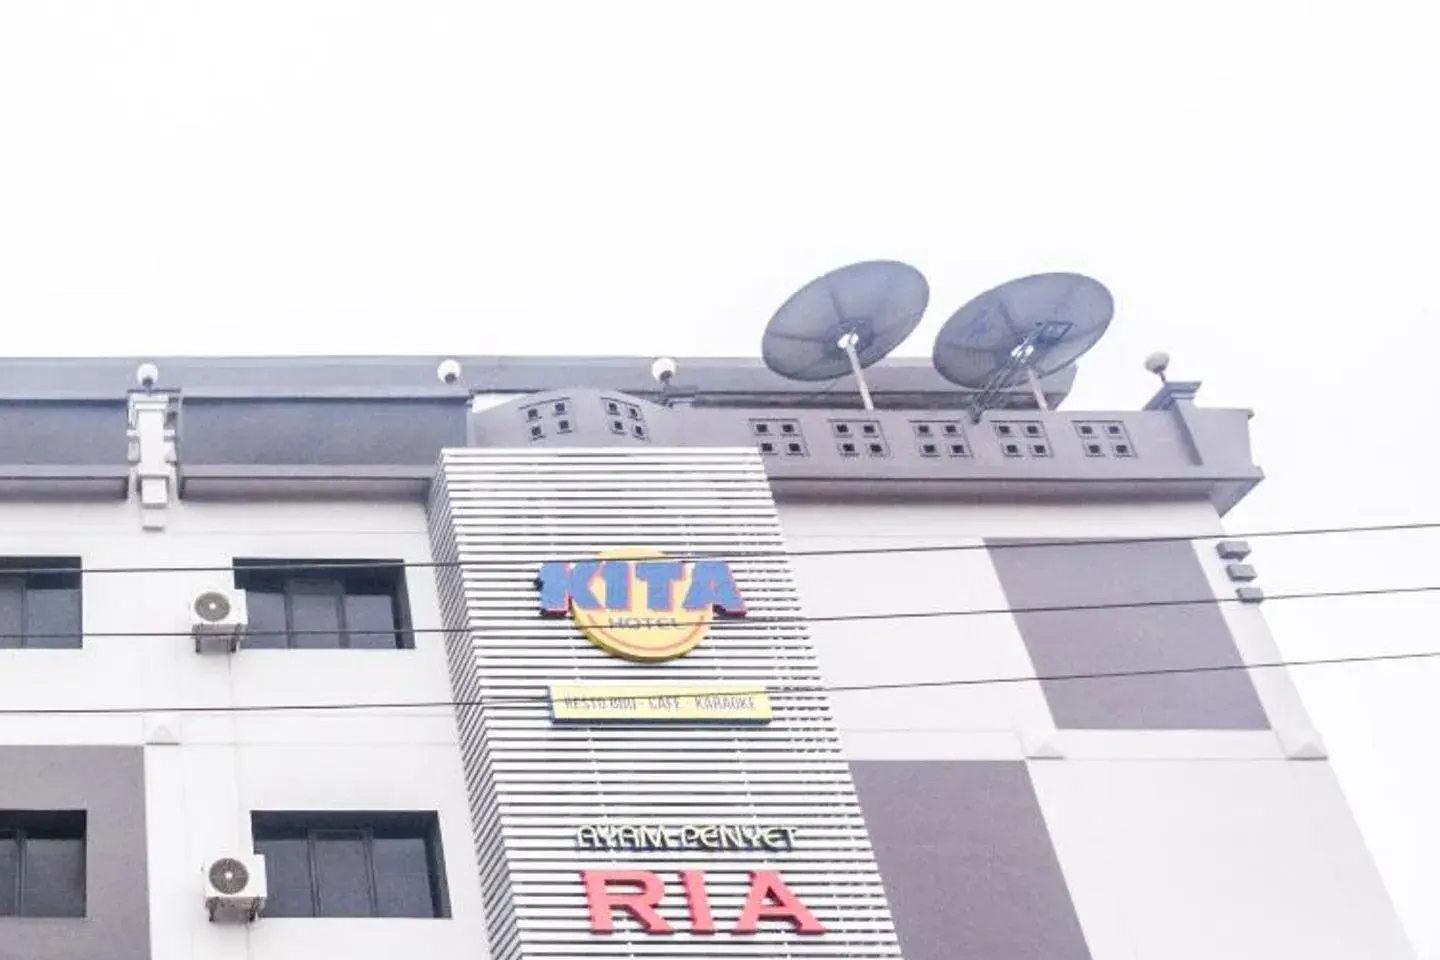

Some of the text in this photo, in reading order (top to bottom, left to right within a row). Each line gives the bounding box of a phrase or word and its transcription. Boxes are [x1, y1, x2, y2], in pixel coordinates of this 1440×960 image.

[537, 560, 748, 616] KITA
[608, 617, 685, 630] HOTEL
[576, 824, 797, 850] AYAM PENYET
[578, 869, 827, 935] RIA
